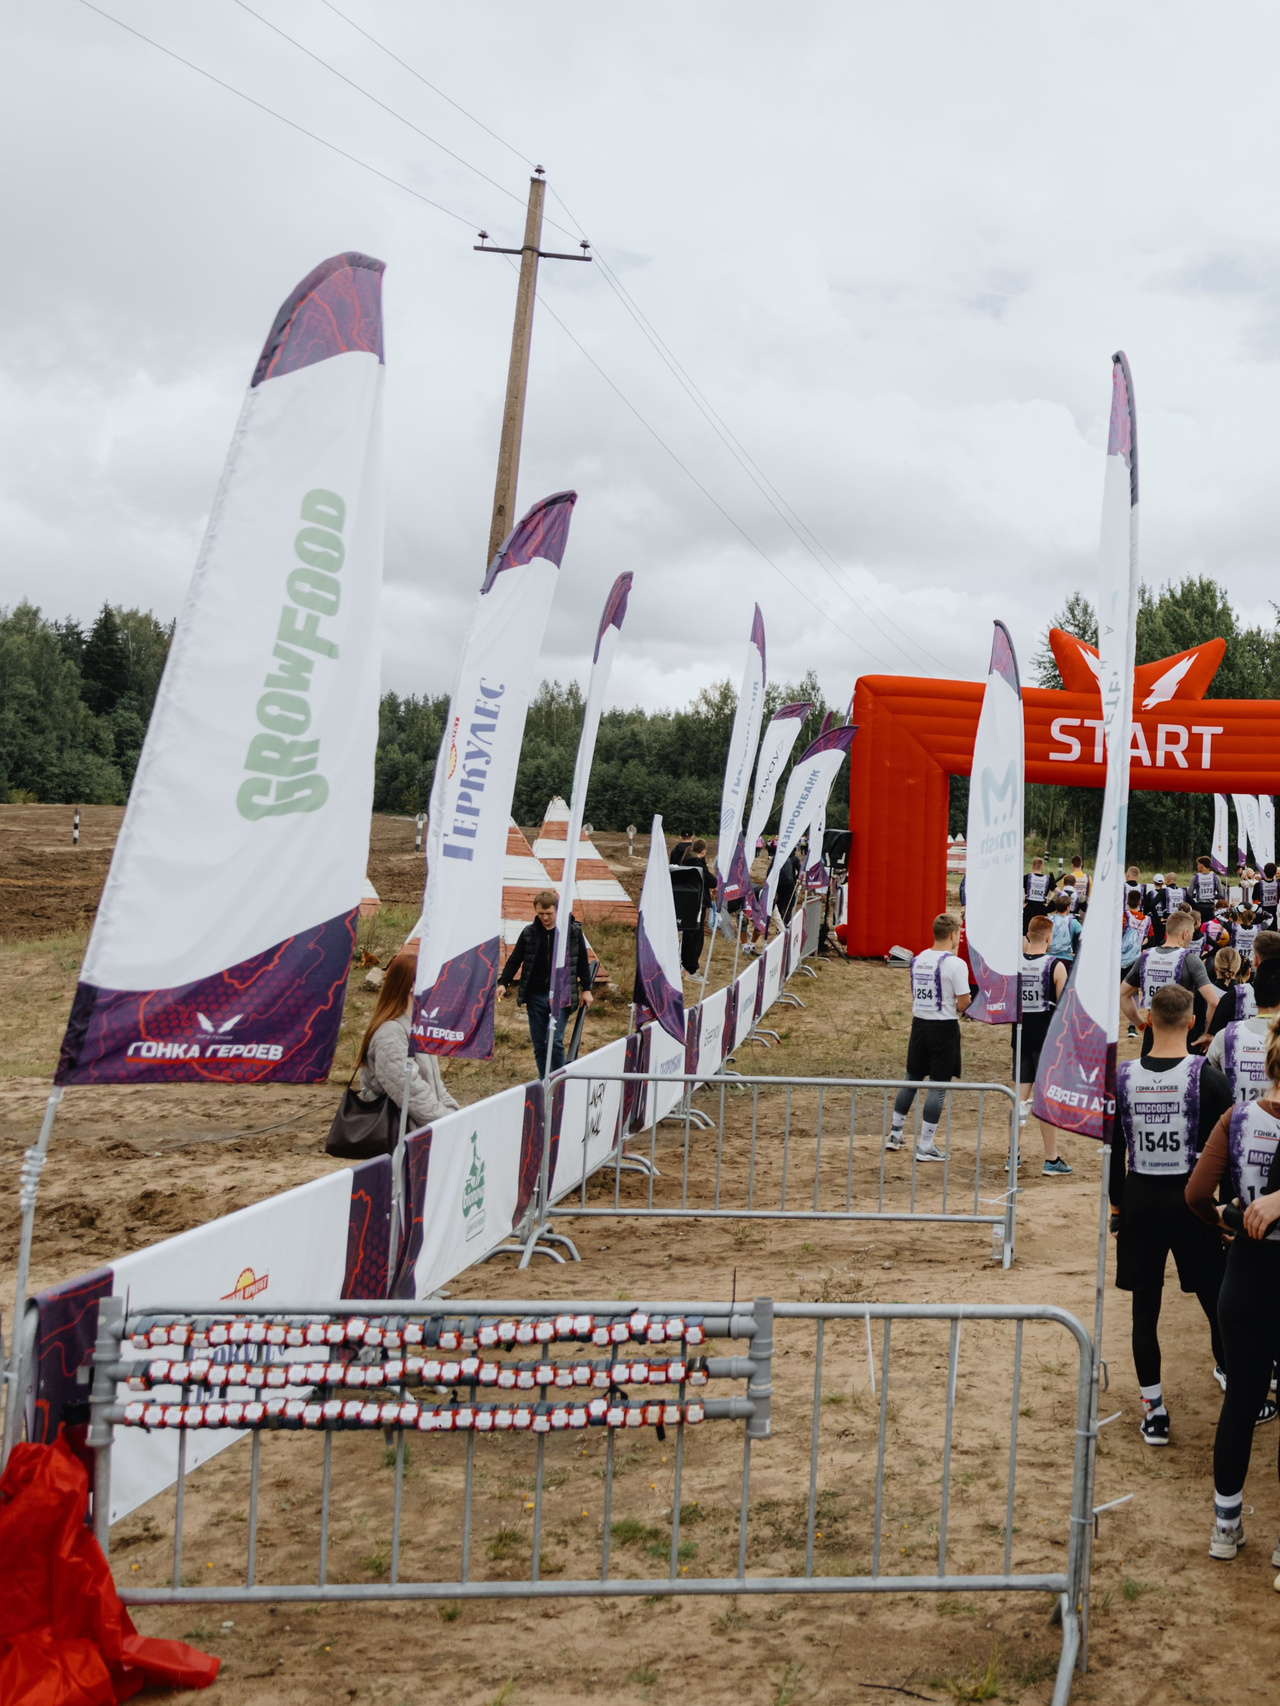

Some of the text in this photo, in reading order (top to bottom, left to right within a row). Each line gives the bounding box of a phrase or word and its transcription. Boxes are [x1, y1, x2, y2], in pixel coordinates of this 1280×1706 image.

[236, 488, 346, 822] GROWFOOD
[1049, 717, 1224, 769] START
[442, 677, 506, 862] ГЕРКУЛЕС
[426, 1026, 465, 1042] ГЕРОЕВ
[126, 1041, 285, 1061] ГОНКА ГЕРОЕВ
[1136, 1102, 1179, 1114] МАССОВЫЙ
[1145, 1114, 1169, 1123] СТАРТ
[1138, 1131, 1181, 1152] 1545
[1254, 1129, 1277, 1139] ГОНКА
